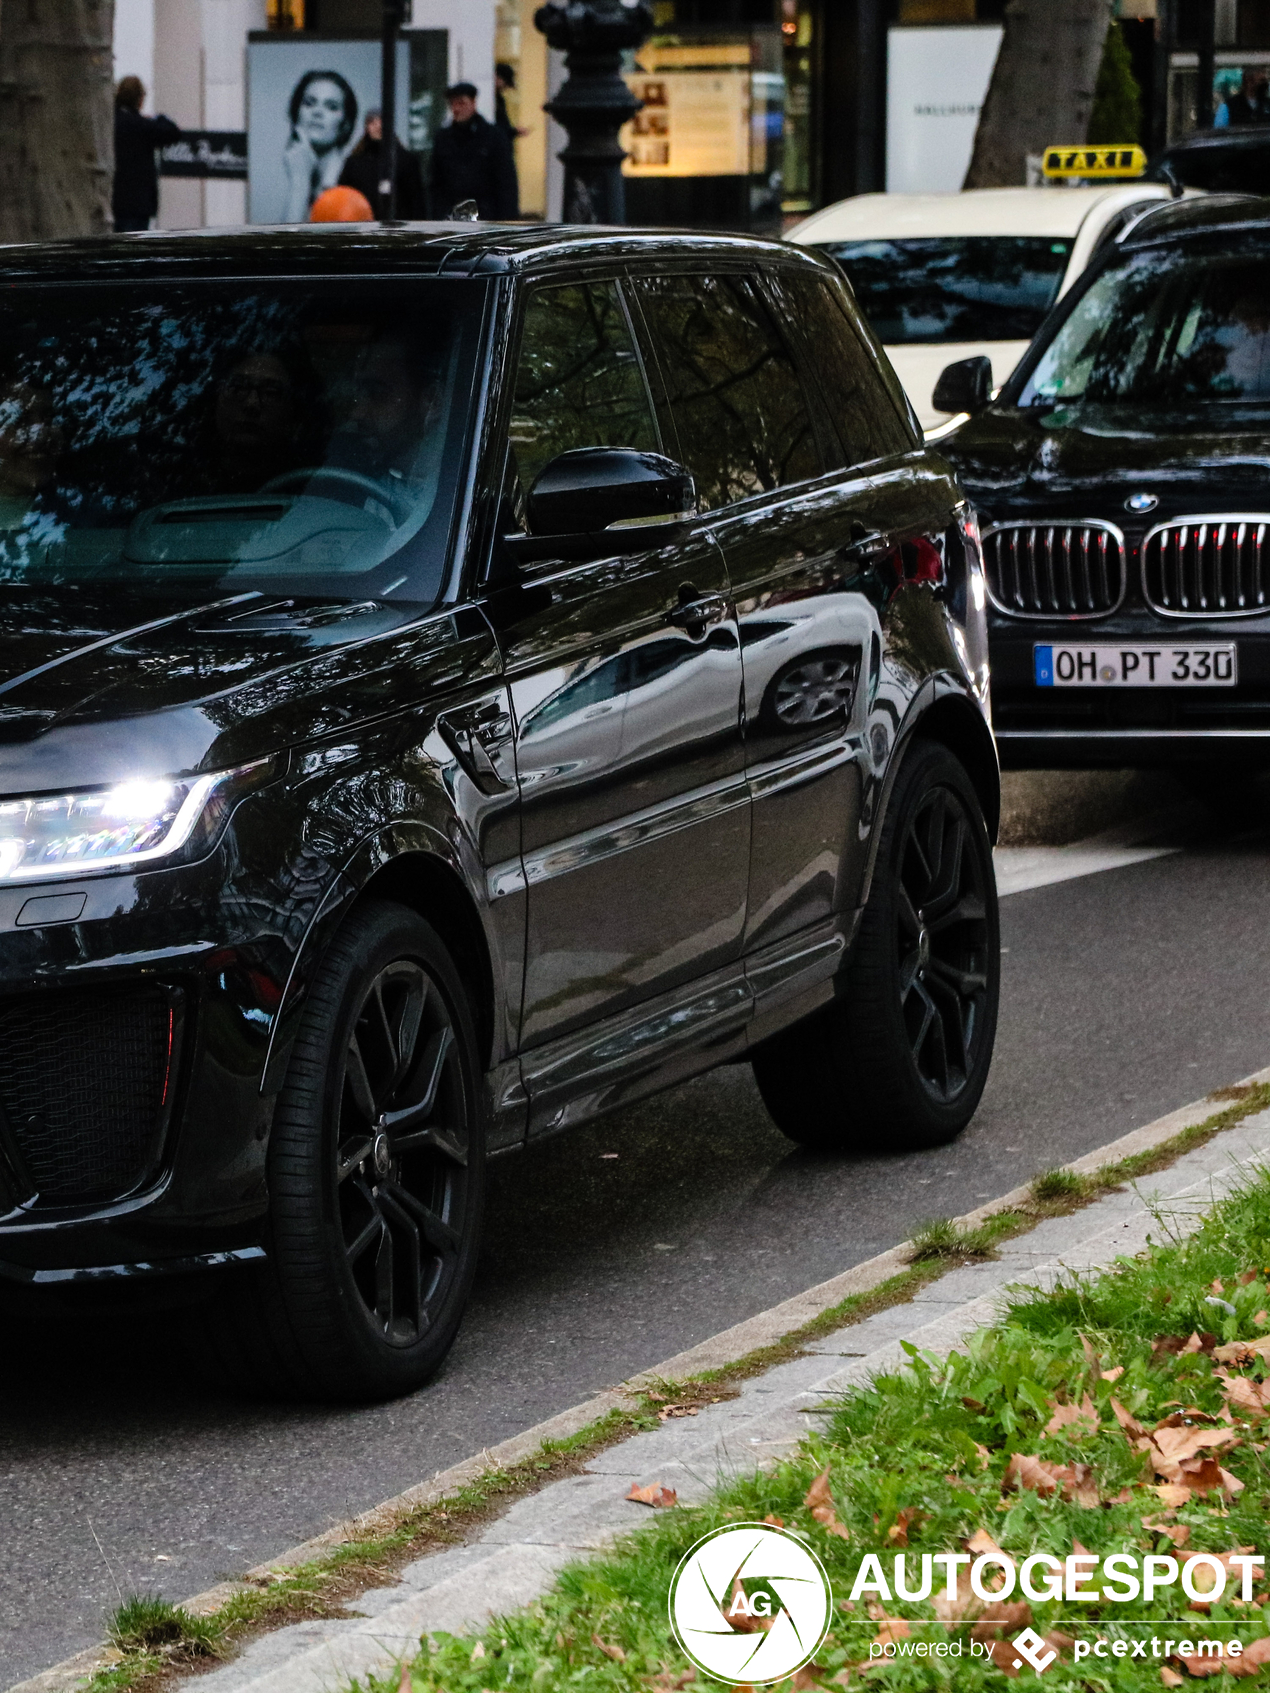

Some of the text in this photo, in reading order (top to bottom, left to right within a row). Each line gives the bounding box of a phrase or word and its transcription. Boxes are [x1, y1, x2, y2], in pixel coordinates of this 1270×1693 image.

[1057, 151, 1122, 170] TAXI
[1056, 651, 1232, 681] OH PT 330
